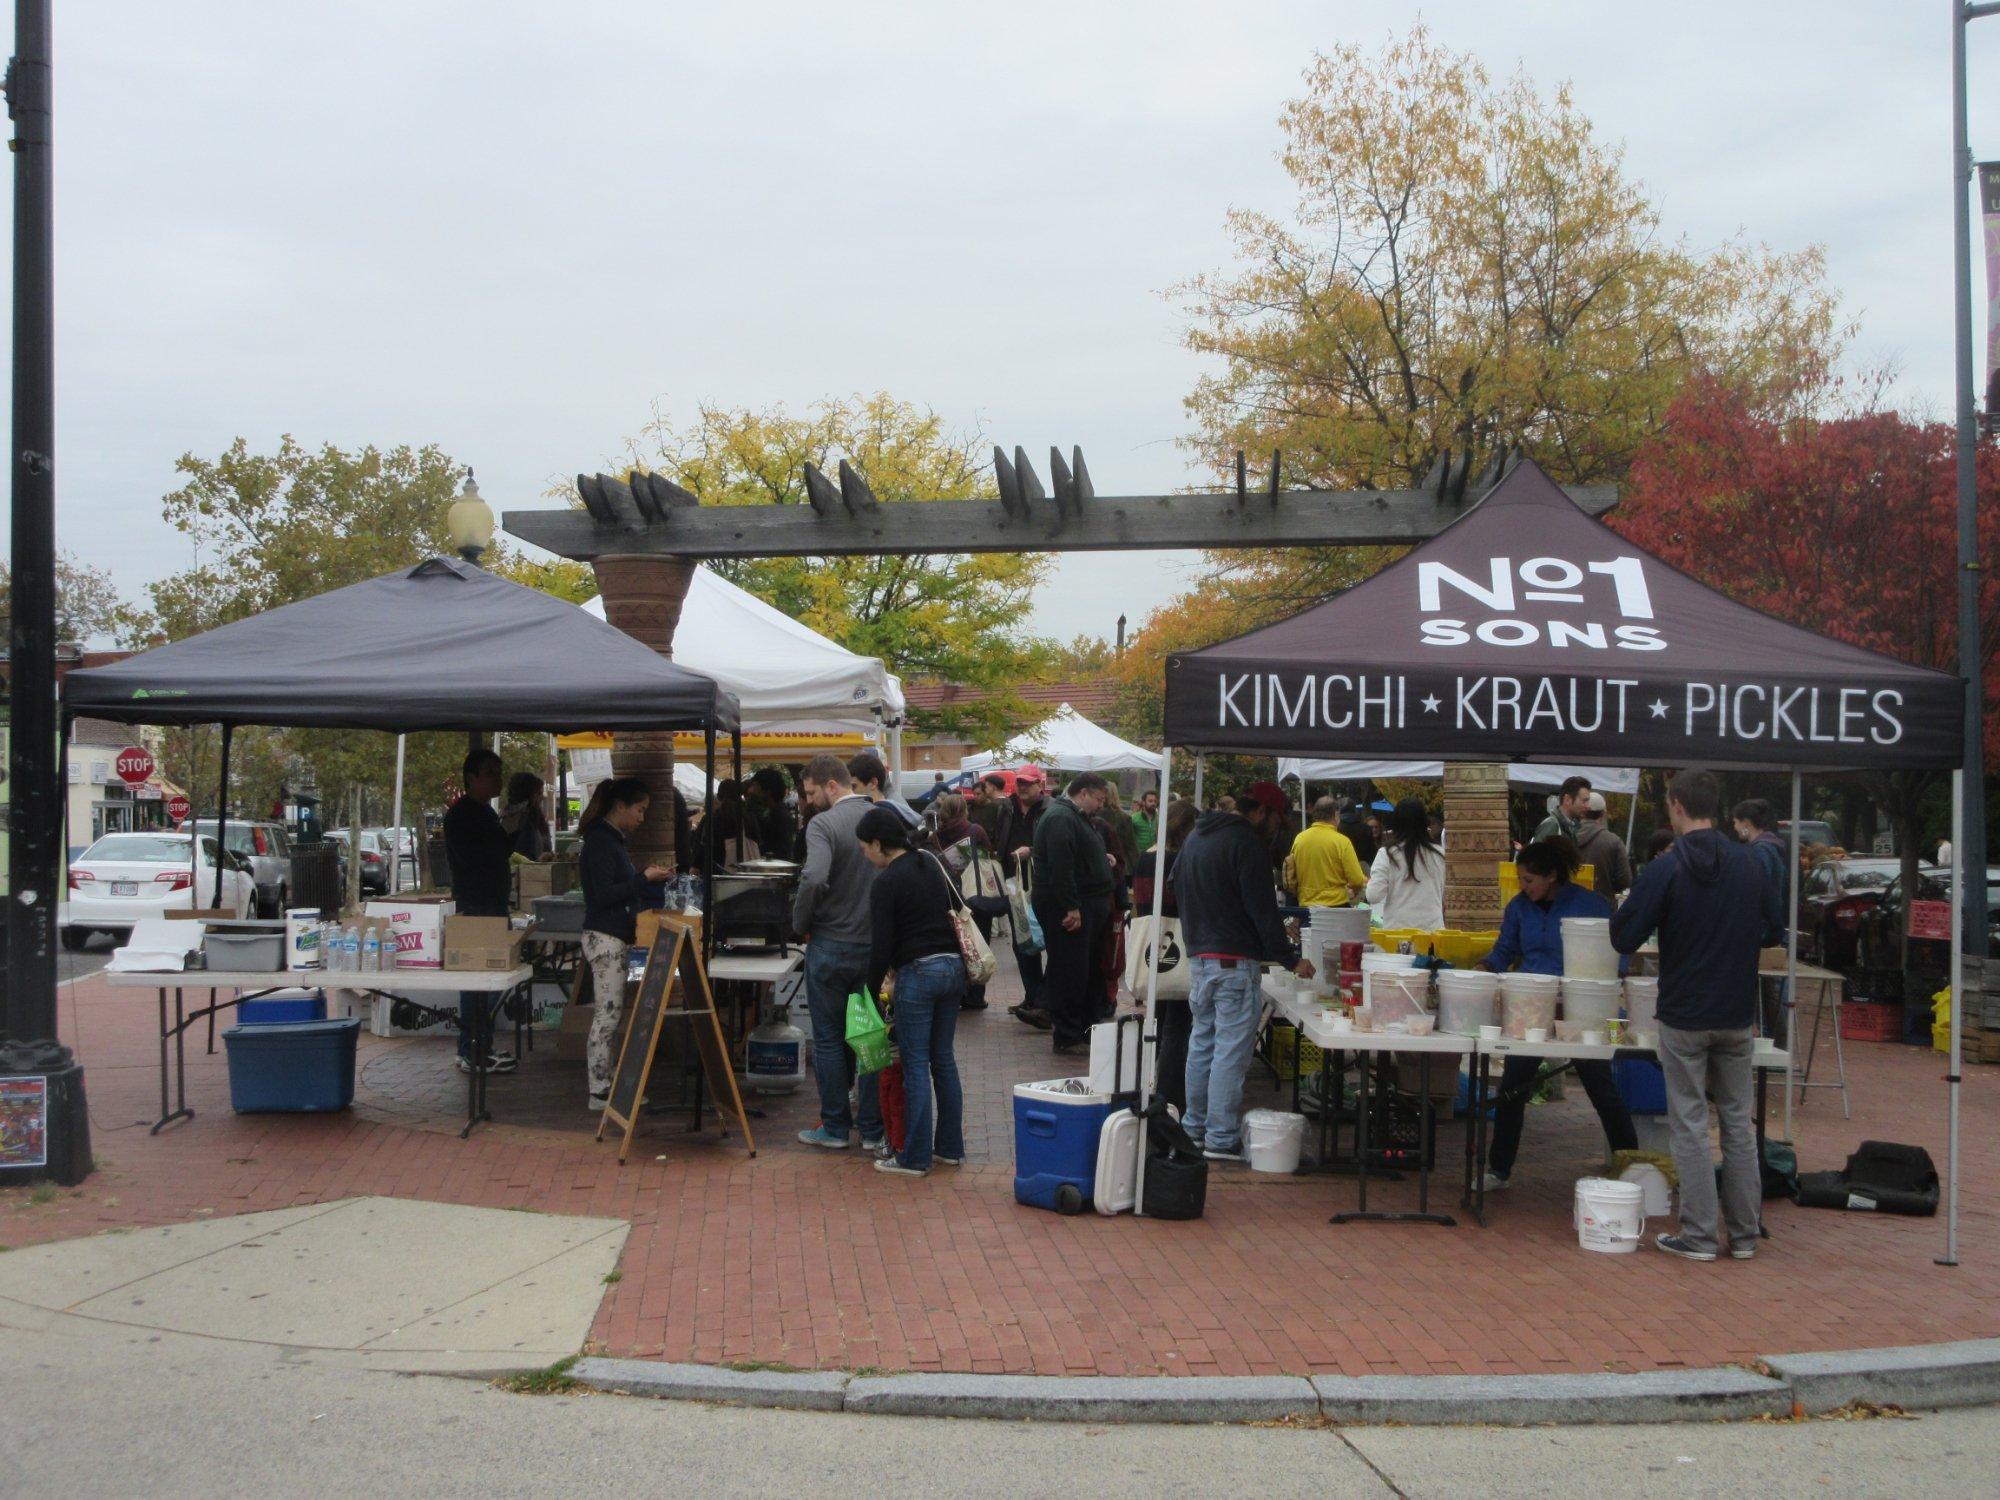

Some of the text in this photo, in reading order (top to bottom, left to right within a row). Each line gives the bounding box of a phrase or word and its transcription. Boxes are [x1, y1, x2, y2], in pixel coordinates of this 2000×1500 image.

[1420, 619, 1668, 651] SONS
[1219, 673, 1903, 745] KIMCHI KRAUT PICKLES
[118, 758, 152, 773] STOP
[169, 803, 189, 812] STOP
[302, 806, 310, 819] P
[1875, 843, 1892, 854] 25
